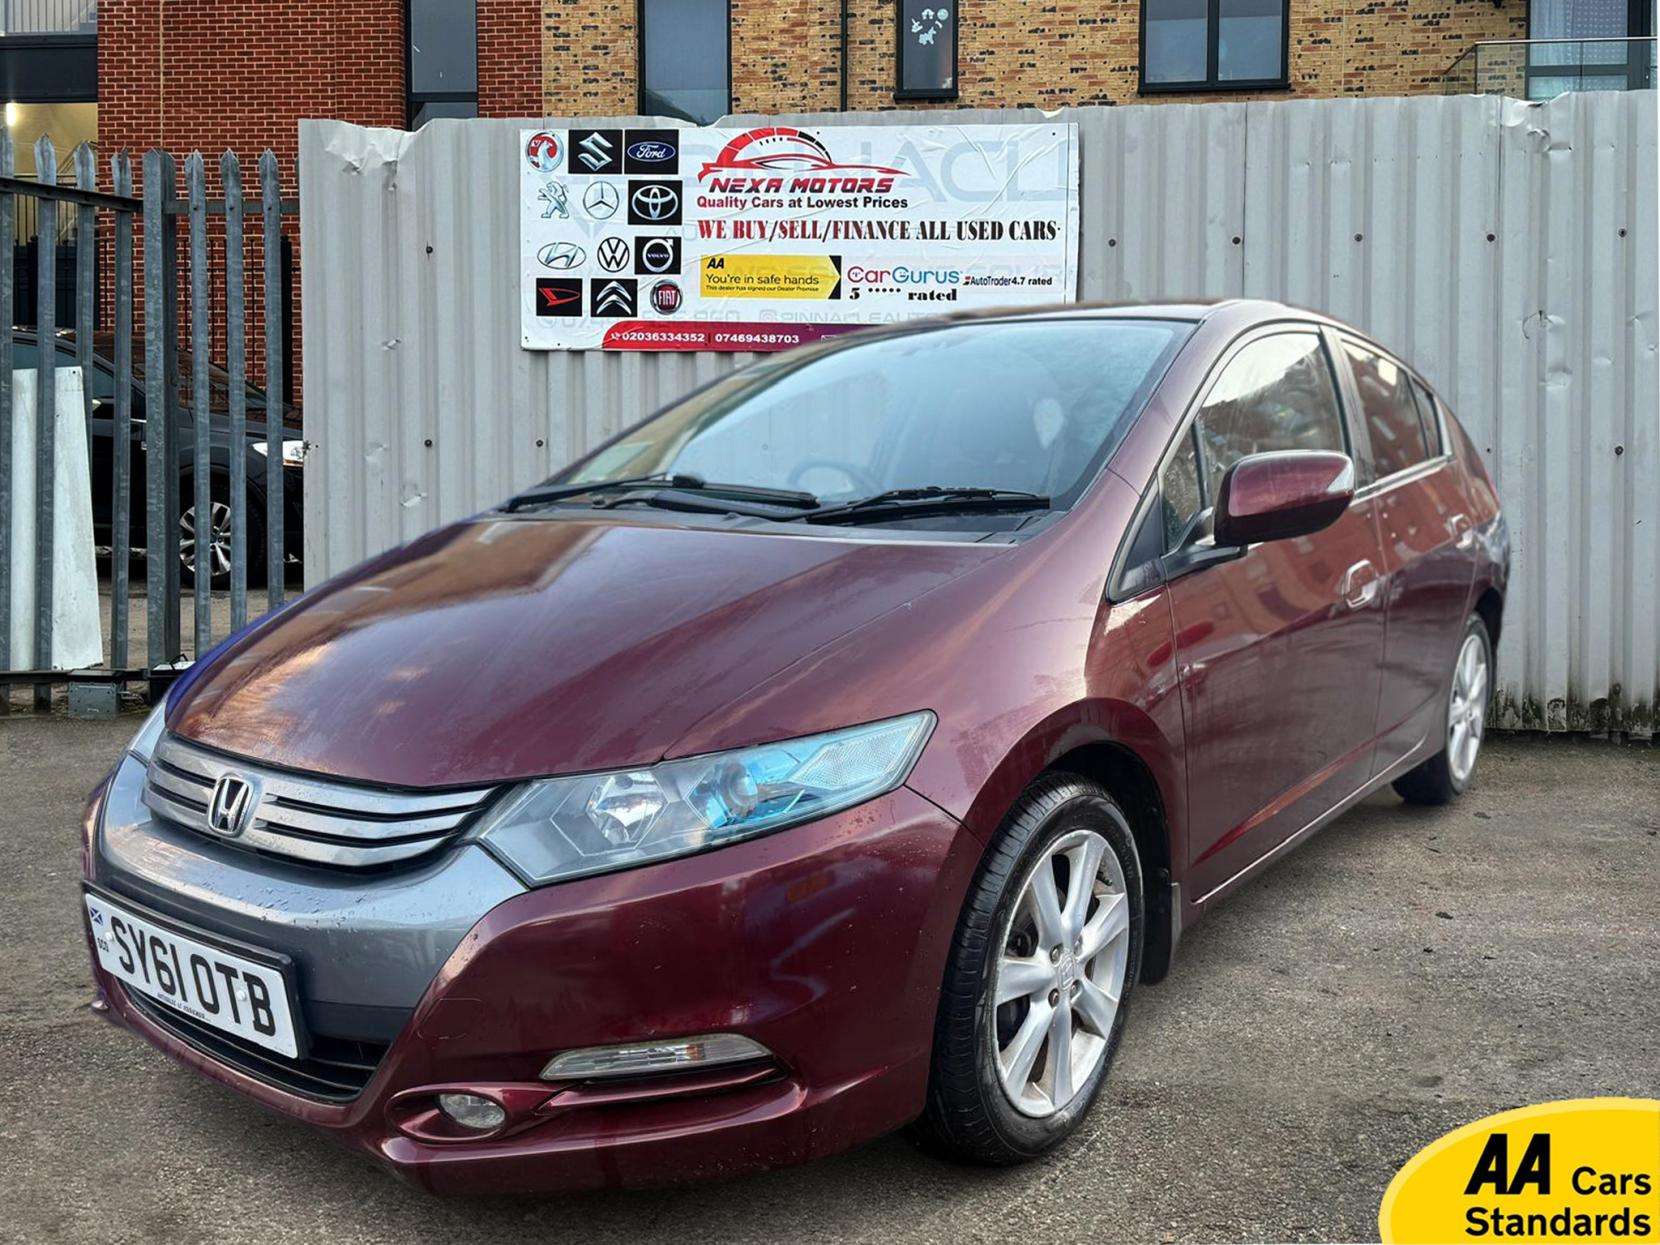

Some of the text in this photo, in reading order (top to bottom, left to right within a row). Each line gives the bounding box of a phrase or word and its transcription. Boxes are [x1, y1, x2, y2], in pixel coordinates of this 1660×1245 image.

[709, 177, 895, 193] NEXA MOTORS
[697, 196, 908, 211] Quality Cars at Lowest Prices
[698, 219, 727, 240] WE
[916, 220, 951, 240] ALL
[956, 219, 1004, 240] USED
[706, 257, 725, 269] AA
[705, 273, 819, 285] You're in safe hands
[847, 266, 960, 284] CarGurus
[1028, 277, 1053, 286] rated
[658, 290, 676, 306] FIAT
[849, 287, 957, 301] 5 rated
[622, 333, 800, 343] 02036334352 07469438703
[110, 916, 276, 1037] SY61 OTB
